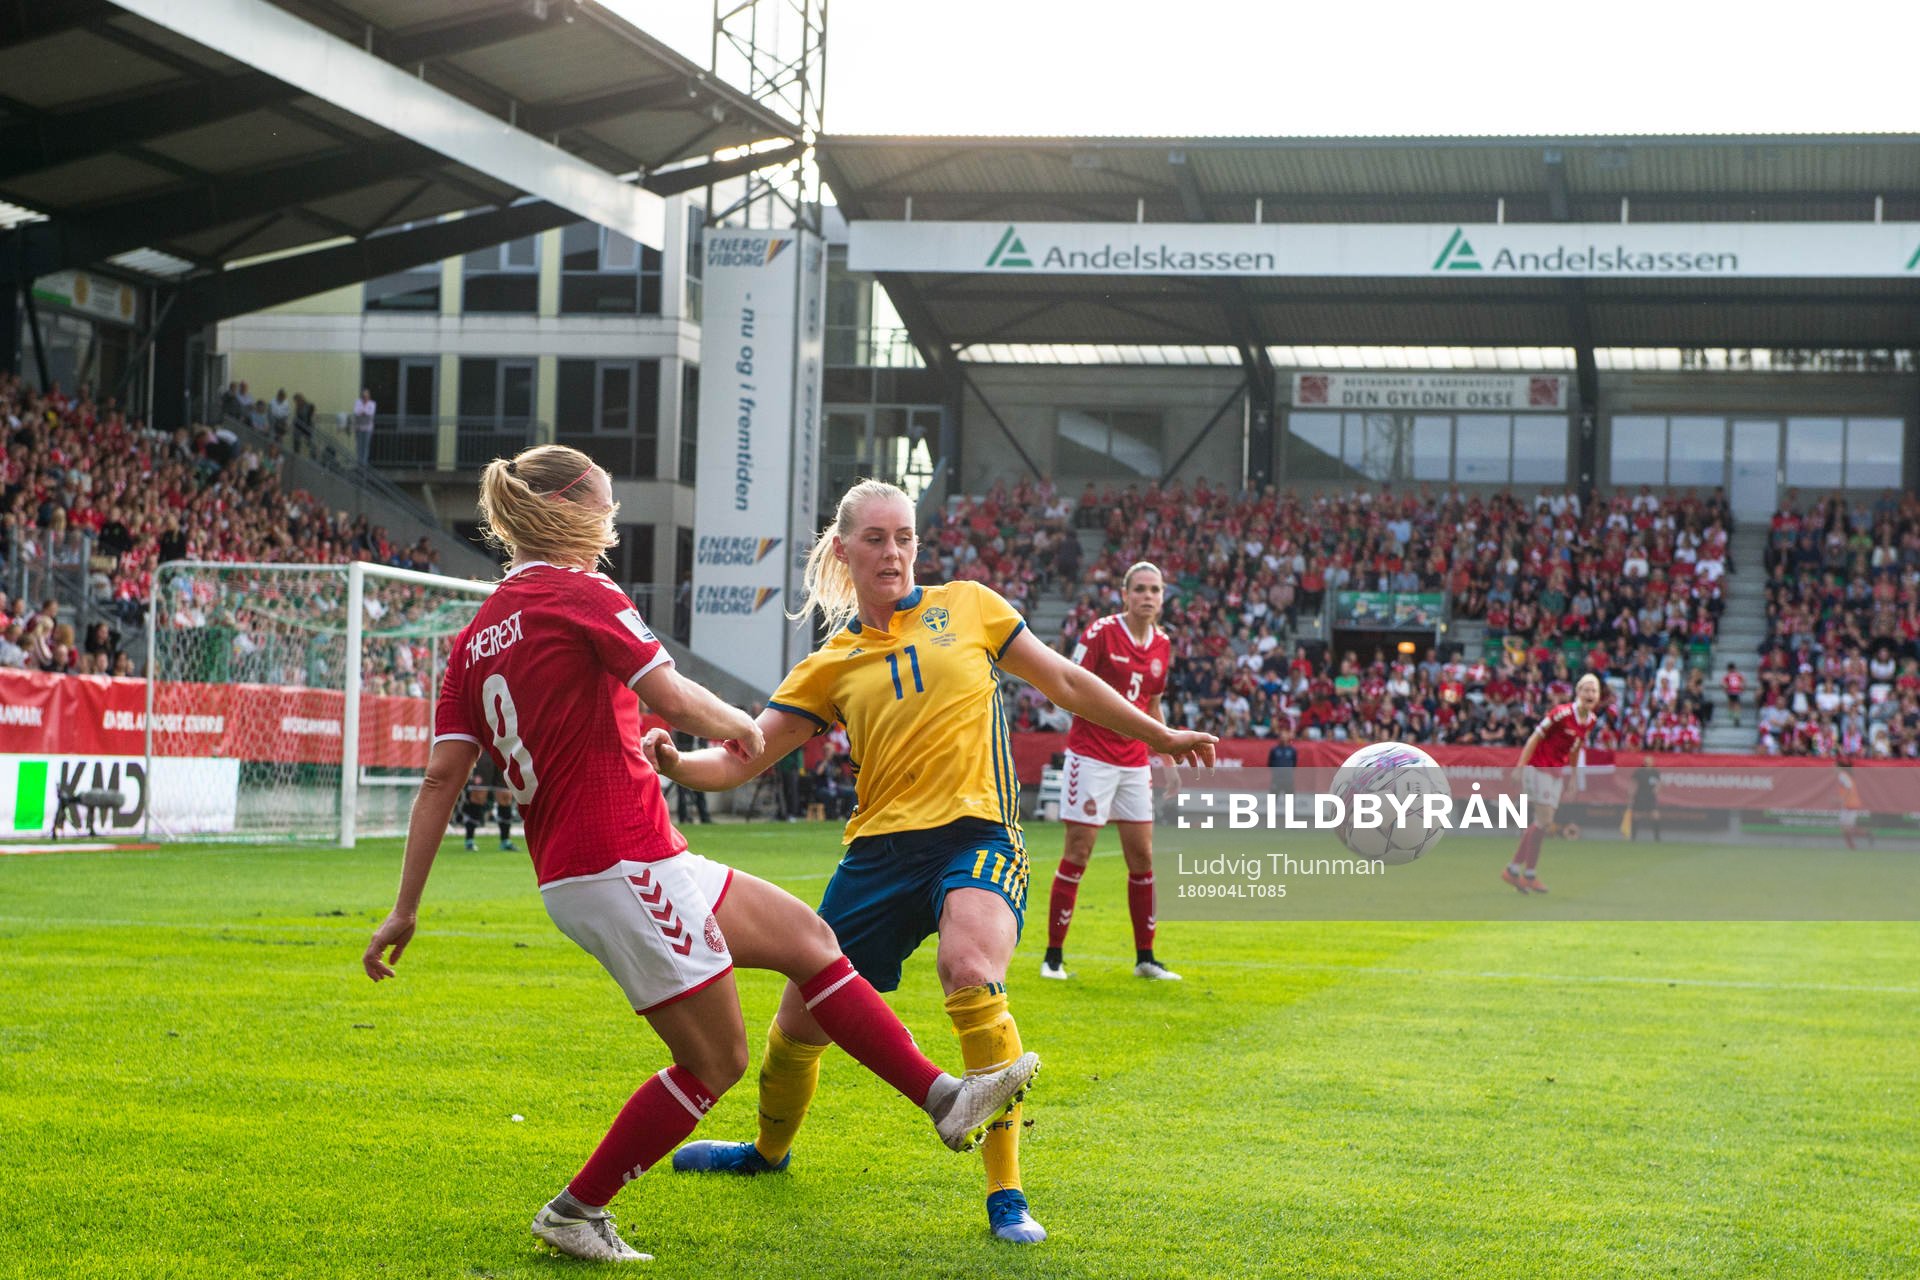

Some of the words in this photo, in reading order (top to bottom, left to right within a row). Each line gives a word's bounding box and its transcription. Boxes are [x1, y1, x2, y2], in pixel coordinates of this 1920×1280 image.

[709, 238, 769, 252] ENERGI
[1041, 243, 1275, 270] Andelskassen
[706, 253, 765, 267] VIBORG
[1491, 245, 1739, 273] Andelskassen
[740, 308, 755, 338] nu
[735, 345, 755, 376] og
[1342, 390, 1380, 405] DEN
[1466, 391, 1514, 407] OKSE
[735, 398, 756, 511] fremtiden
[698, 536, 759, 550] ENERGI
[696, 551, 755, 566] VIBORG
[696, 585, 757, 599] ENERGI
[694, 599, 754, 615] VIBORG
[884, 644, 924, 700] 11
[1127, 671, 1143, 702] 5
[0, 706, 42, 727] ANMARK
[482, 673, 538, 805] 8
[55, 760, 147, 830] KMD
[972, 849, 1007, 885] 11
